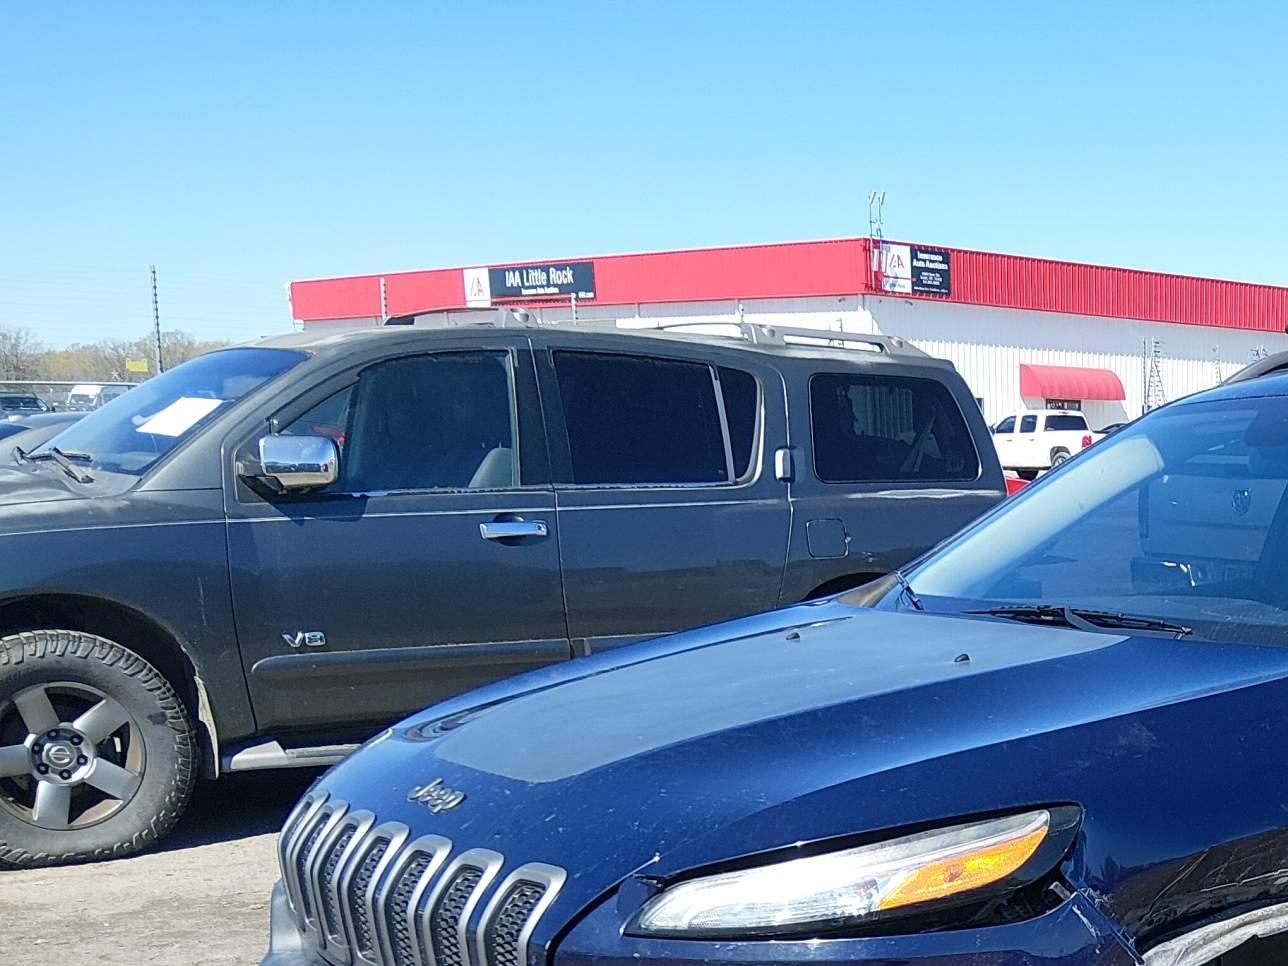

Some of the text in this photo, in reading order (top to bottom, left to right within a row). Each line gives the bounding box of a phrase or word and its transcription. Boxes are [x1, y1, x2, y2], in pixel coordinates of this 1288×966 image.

[505, 271, 521, 287] IAA
[523, 268, 548, 287] Little
[549, 265, 574, 284] Rock
[281, 631, 326, 648] V8
[407, 777, 465, 816] Jeep
